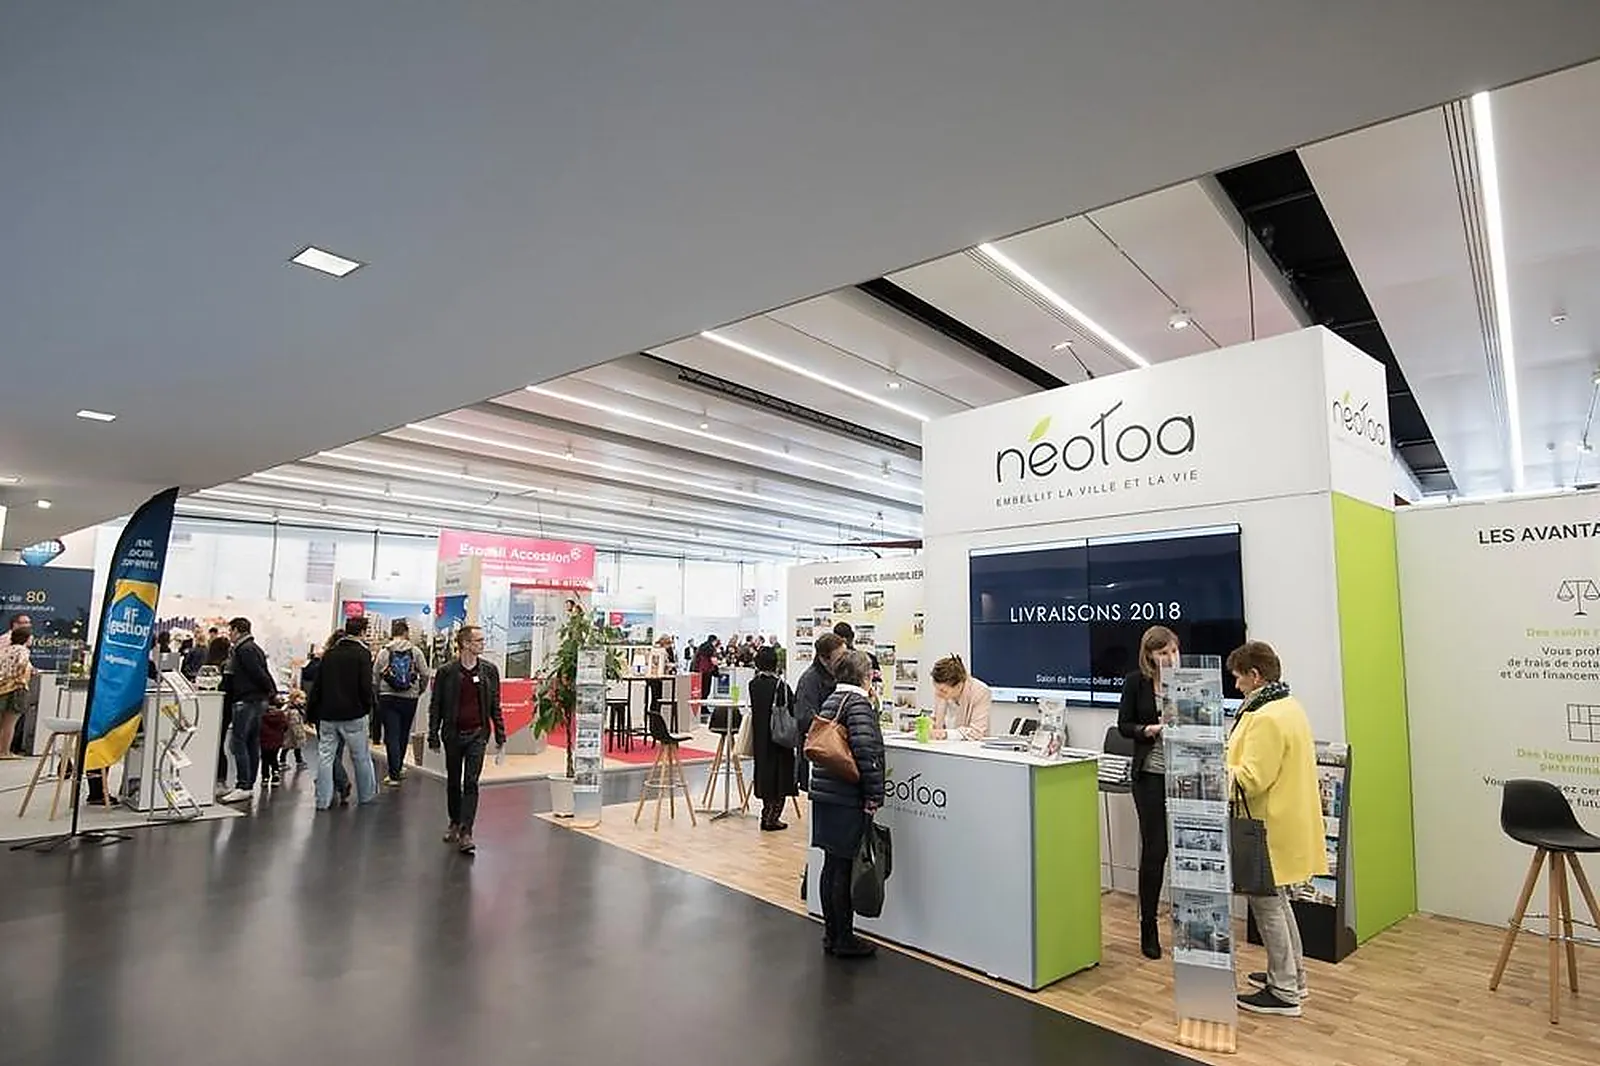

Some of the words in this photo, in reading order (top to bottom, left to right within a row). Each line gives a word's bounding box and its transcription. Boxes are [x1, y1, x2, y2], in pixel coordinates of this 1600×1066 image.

[996, 491, 1053, 507] EMBELLIT
[1058, 488, 1073, 499] LA
[1079, 481, 1117, 496] VILLE
[1124, 477, 1140, 490] ET
[1148, 475, 1165, 486] LA
[1173, 469, 1198, 483] VIE
[1478, 529, 1516, 545] LES
[1521, 522, 1600, 542] AVANTA
[511, 548, 571, 564] Accession
[829, 573, 878, 585] PROGRAMMES
[26, 590, 46, 604] 80
[1010, 603, 1121, 623] LIVRAISONS
[1130, 602, 1182, 621] 2018
[1541, 646, 1572, 656] Vous
[1508, 658, 1521, 668] de
[1524, 657, 1551, 668] frais
[1554, 659, 1569, 668] de
[1572, 660, 1600, 669] nota
[1500, 670, 1512, 679] et
[1515, 670, 1539, 680] d'un
